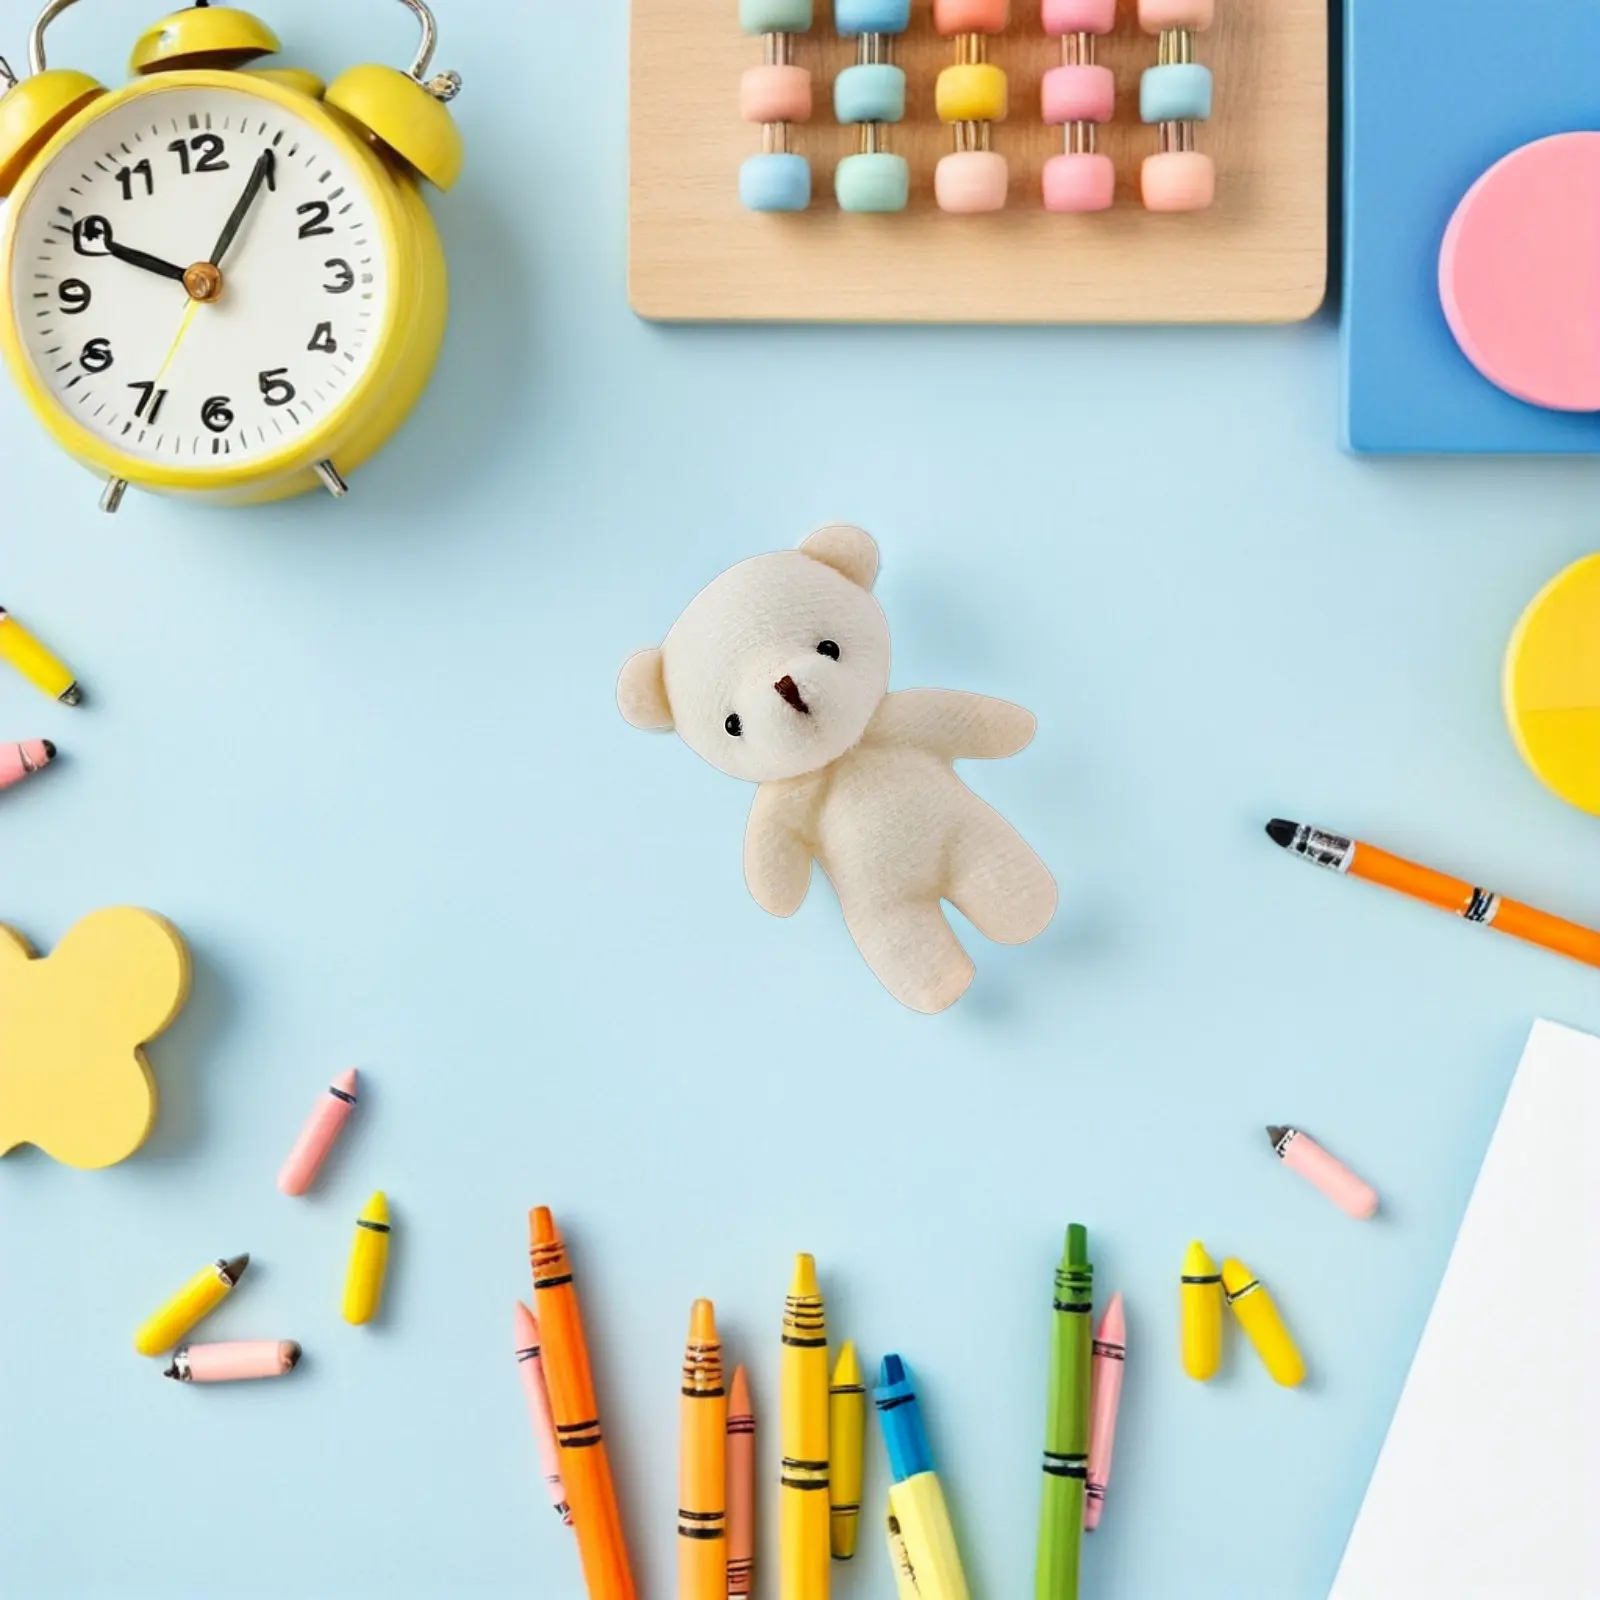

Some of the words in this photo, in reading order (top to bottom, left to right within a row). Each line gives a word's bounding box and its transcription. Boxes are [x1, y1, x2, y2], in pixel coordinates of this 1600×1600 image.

[168, 134, 229, 174] 12
[115, 159, 153, 200] 11
[297, 201, 334, 239] 2
[323, 258, 354, 293] 3
[58, 278, 91, 314] 9
[307, 321, 336, 353] 4
[259, 367, 296, 406] 5
[201, 396, 234, 433] 6
